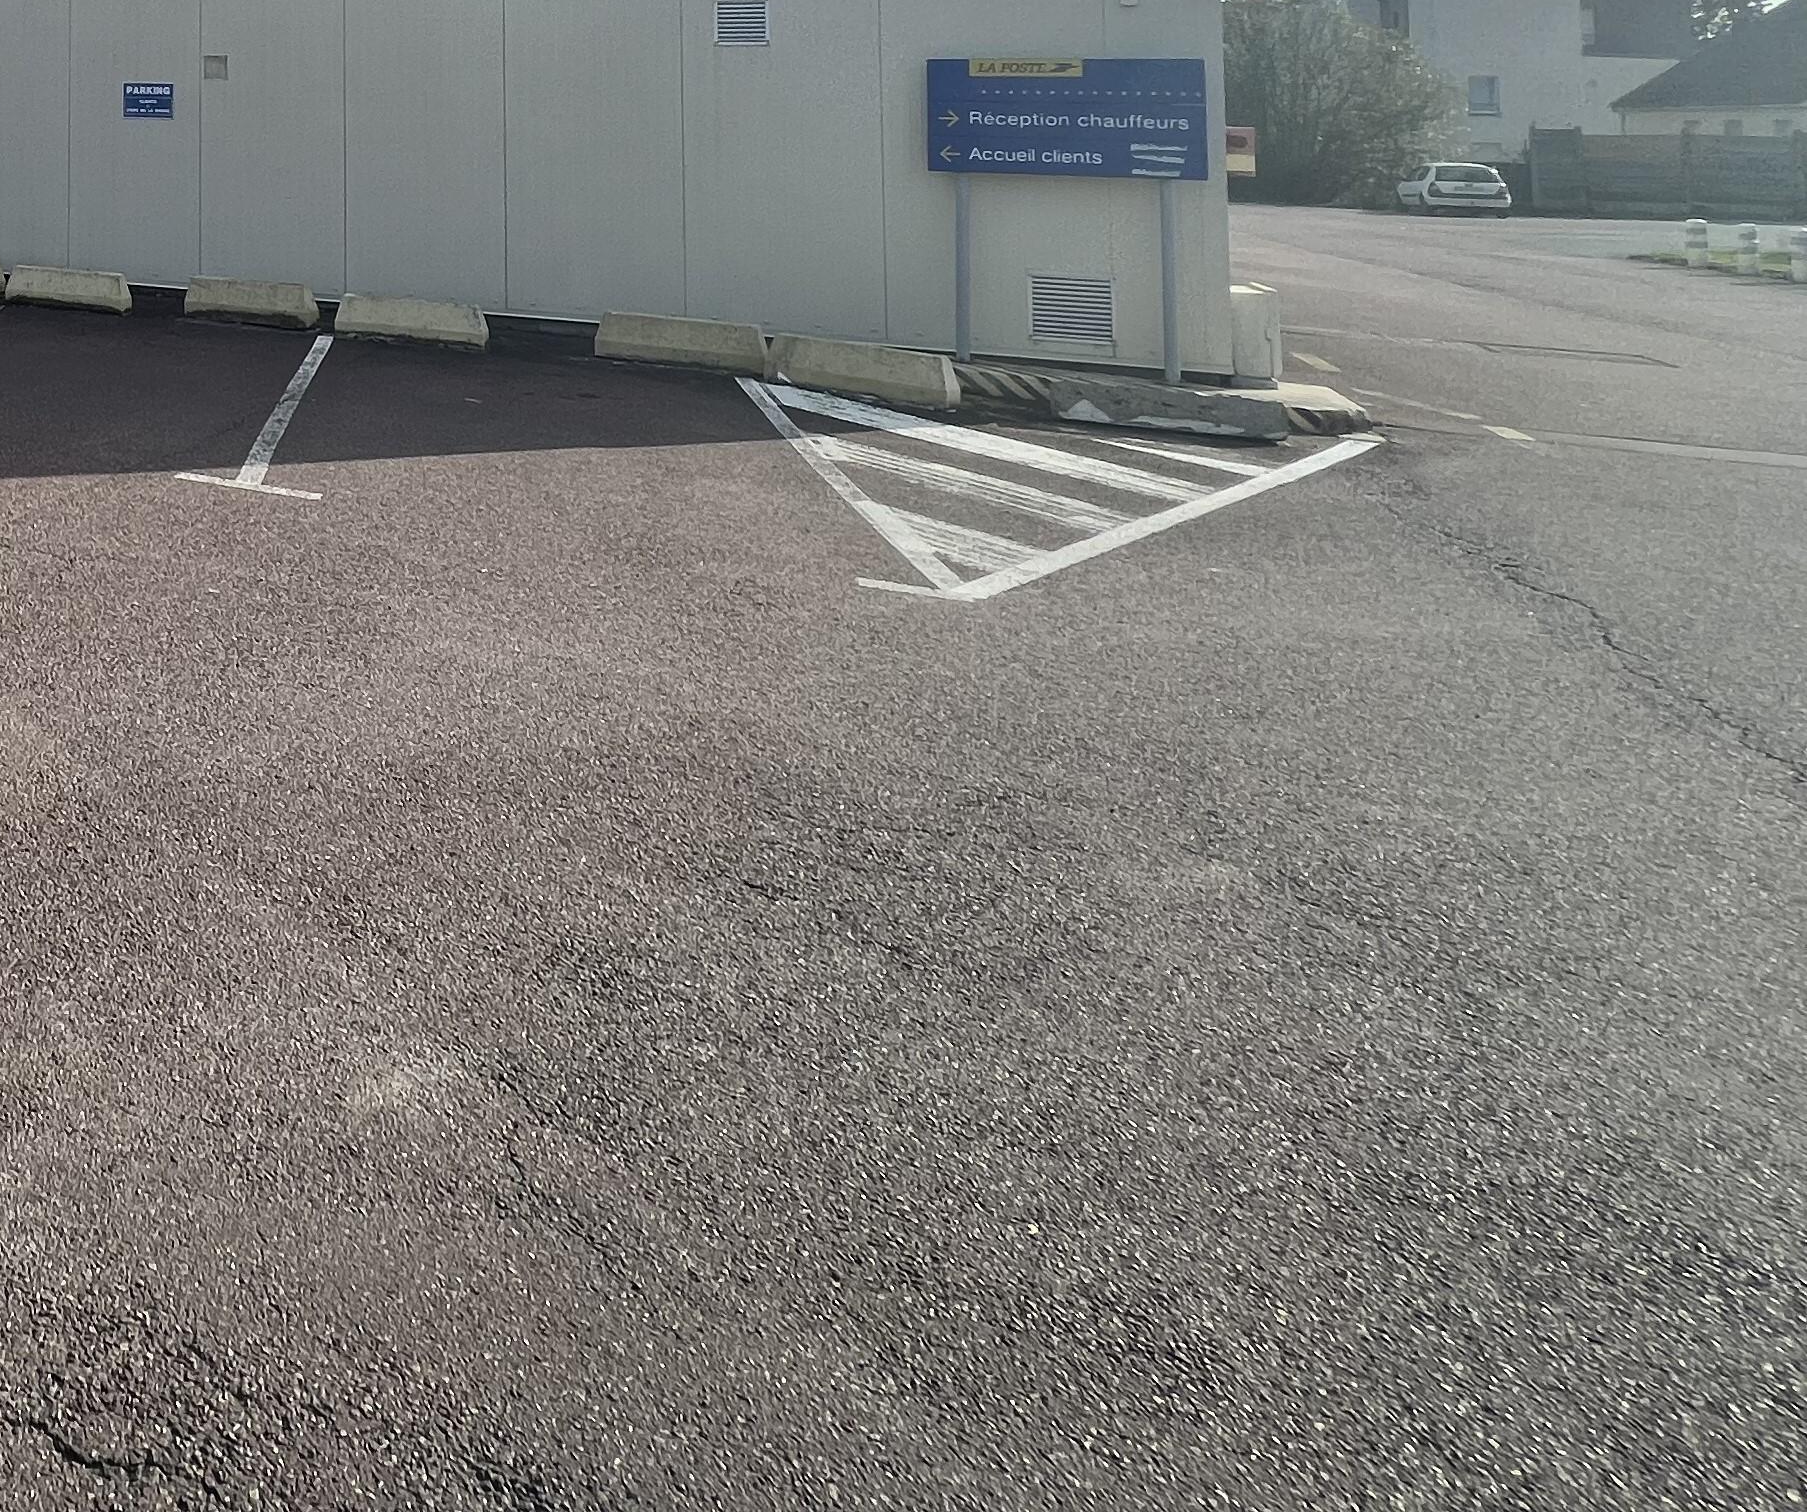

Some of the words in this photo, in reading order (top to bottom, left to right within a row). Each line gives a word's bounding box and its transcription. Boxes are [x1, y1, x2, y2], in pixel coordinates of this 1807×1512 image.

[976, 62, 996, 74] LA
[1000, 61, 1048, 74] POSTE
[126, 85, 171, 95] PARKING
[969, 110, 1070, 128] Réception
[1077, 112, 1190, 131] chauffeurs
[968, 146, 1036, 163] Accueil
[1041, 150, 1103, 165] clients
